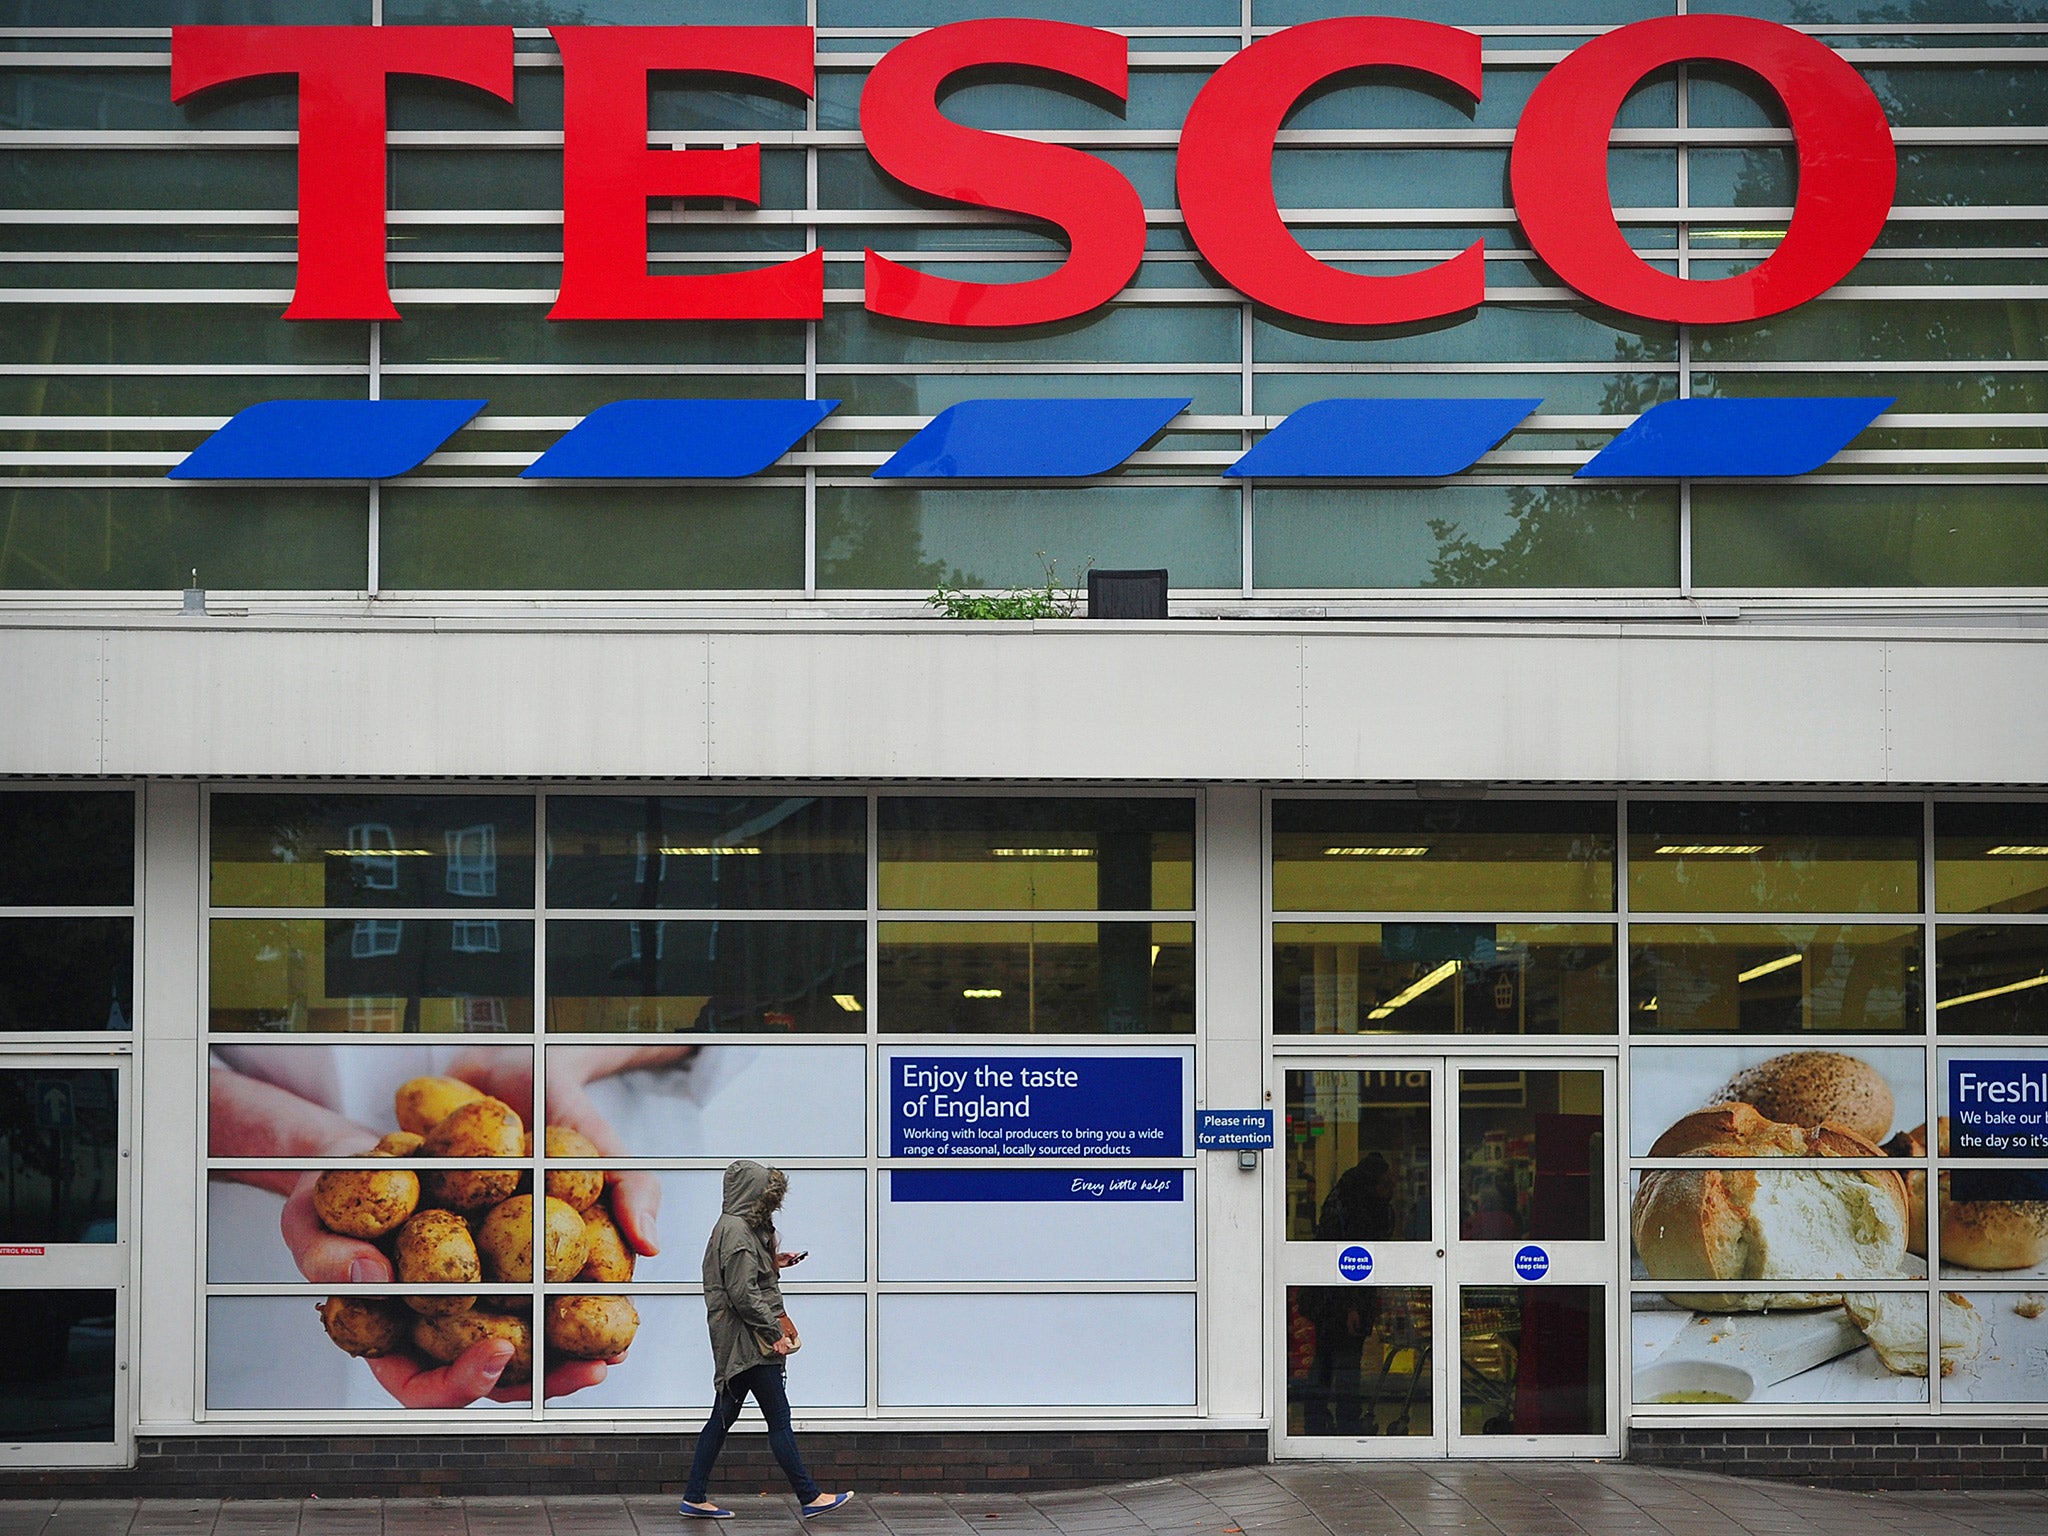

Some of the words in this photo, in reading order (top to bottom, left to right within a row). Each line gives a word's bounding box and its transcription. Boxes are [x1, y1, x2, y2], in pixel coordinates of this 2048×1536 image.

[171, 14, 1897, 326] TESCO
[903, 1064, 968, 1093] Enjoy
[974, 1064, 1013, 1087] the
[1020, 1067, 1079, 1087] taste
[1960, 1072, 2047, 1103] Freshl
[902, 1094, 929, 1117] of
[934, 1094, 1030, 1123] England
[1204, 1115, 1240, 1126] Please
[1242, 1115, 1266, 1129] ring
[1960, 1110, 1982, 1125] We
[1985, 1110, 2016, 1125] bake
[2019, 1114, 2042, 1125] our
[903, 1128, 949, 1141] Working
[951, 1128, 976, 1139] with
[978, 1128, 1003, 1139] local
[1005, 1128, 1059, 1141] producers
[1061, 1129, 1073, 1139] to
[1075, 1128, 1103, 1141] bring
[1106, 1130, 1126, 1141] you
[1128, 1130, 1136, 1139] a
[1138, 1128, 1165, 1139] wide
[1199, 1133, 1217, 1144] for
[1218, 1132, 1271, 1144] attention
[1960, 1133, 1982, 1147] the
[1985, 1133, 2010, 1150] day
[2012, 1136, 2028, 1147] so
[903, 1146, 935, 1157] range
[937, 1144, 950, 1155] of
[951, 1144, 1000, 1157] seasonal,
[1002, 1144, 1036, 1157] locally
[1038, 1144, 1081, 1155] sourced
[1083, 1144, 1132, 1157] products
[1070, 1178, 1105, 1196] Every
[1108, 1178, 1138, 1191] little
[1140, 1178, 1171, 1193] helps
[21, 1247, 43, 1255] PANEL
[1340, 1263, 1356, 1271] keep
[1516, 1263, 1532, 1271] keep
